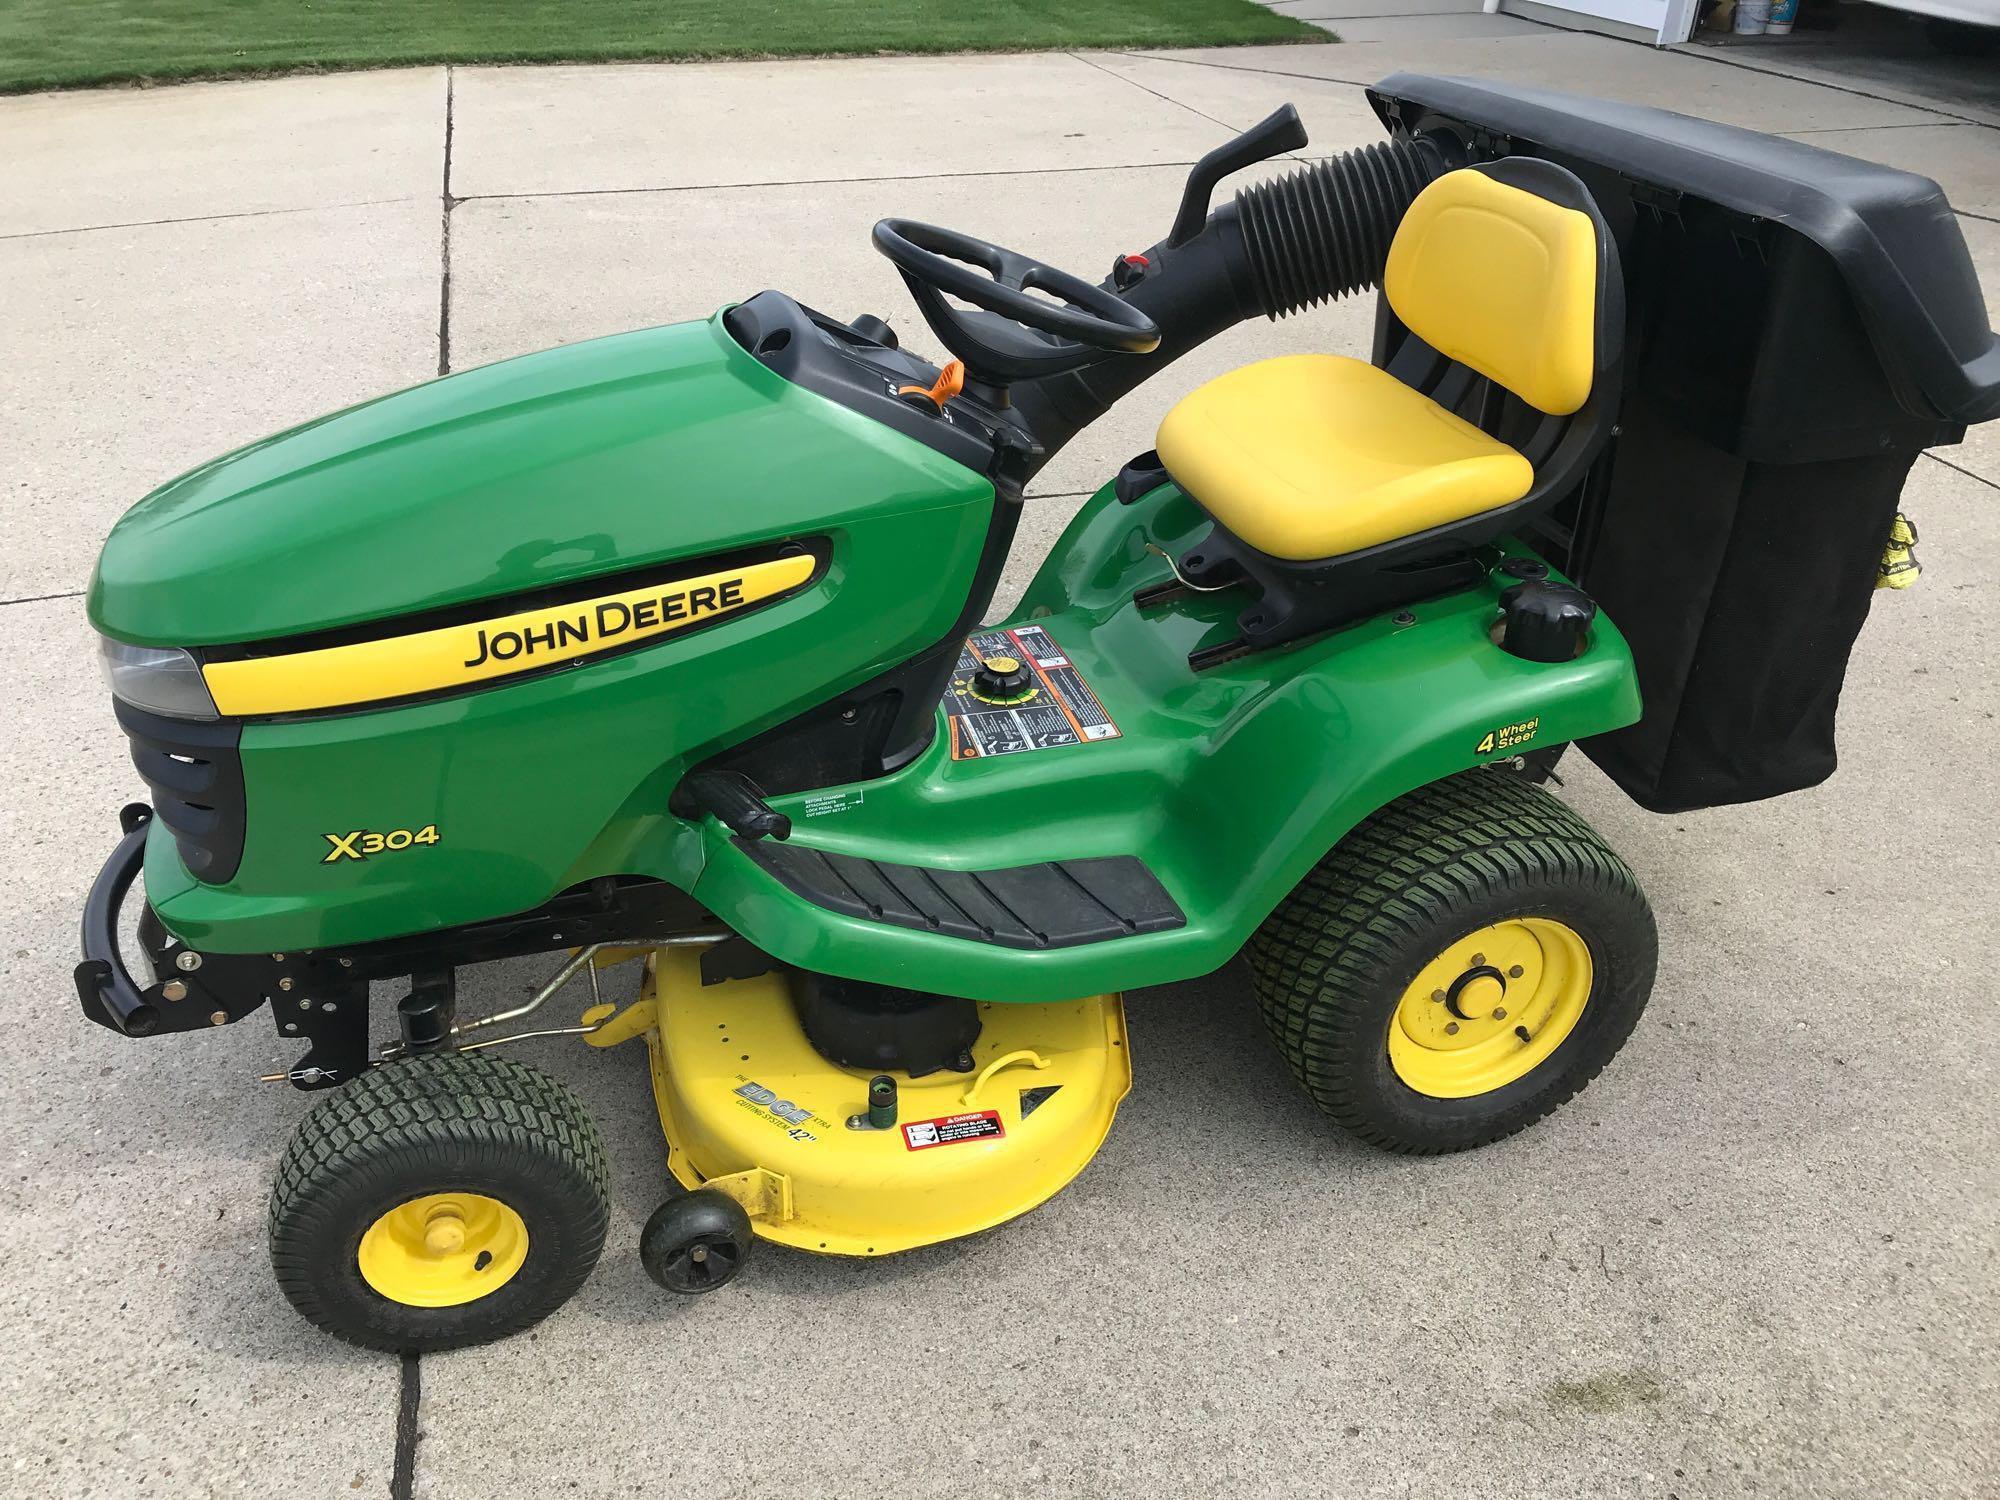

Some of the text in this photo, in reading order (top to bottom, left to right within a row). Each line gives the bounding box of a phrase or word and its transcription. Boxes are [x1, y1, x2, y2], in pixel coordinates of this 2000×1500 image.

[464, 578, 745, 668] JOHN DEERE
[1499, 717, 1539, 738] Wheel
[1475, 733, 1494, 753] 4
[1498, 729, 1537, 749] Steer
[806, 800, 836, 808] ATTACHMENTS
[321, 824, 440, 864] X304
[735, 1074, 749, 1082] THE
[732, 1081, 815, 1126] EDGE
[735, 1099, 765, 1116] CUTTING
[761, 1112, 791, 1131] SYSTEM
[954, 1114, 983, 1122] DANGER
